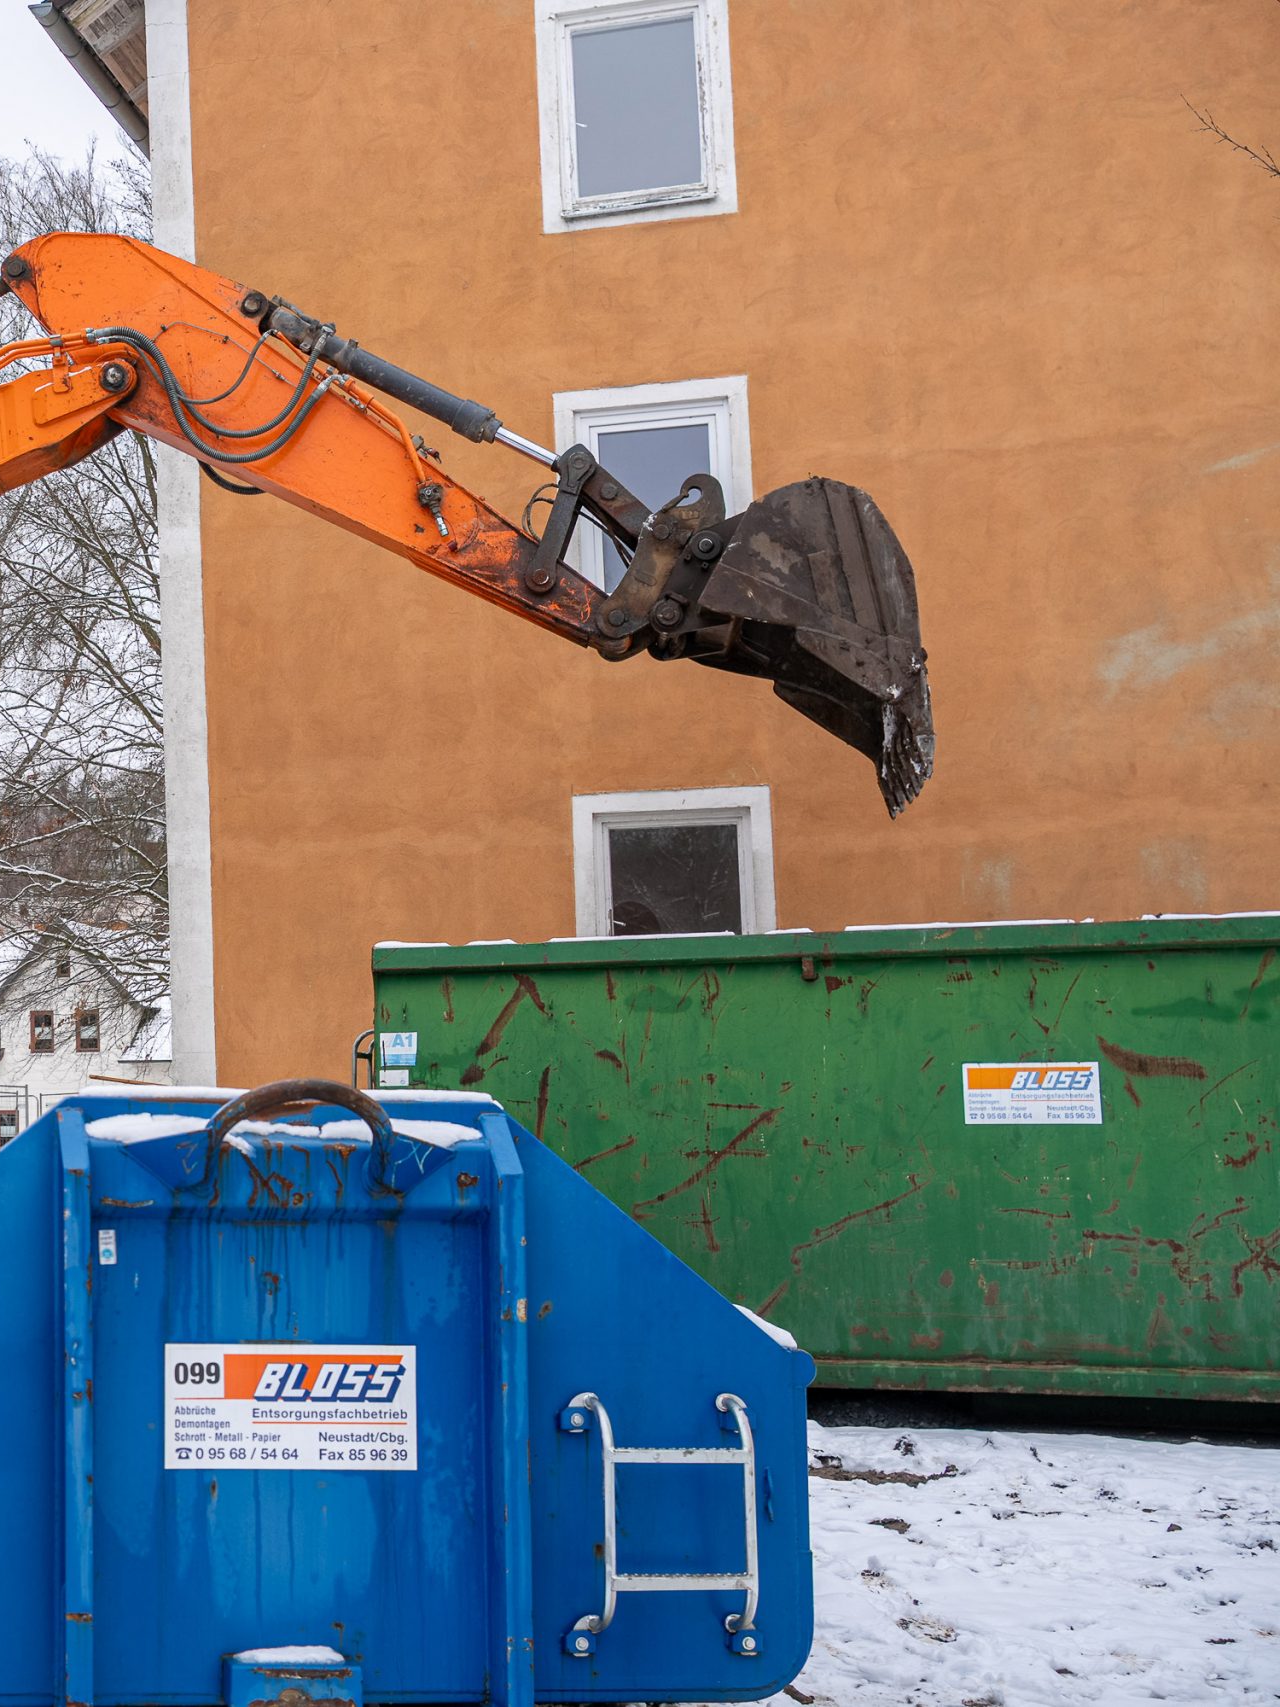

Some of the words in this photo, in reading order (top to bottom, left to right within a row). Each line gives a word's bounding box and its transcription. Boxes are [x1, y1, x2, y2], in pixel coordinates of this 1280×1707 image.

[392, 1034, 413, 1047] A1
[1010, 1071, 1094, 1090] BLOSS
[1011, 1092, 1095, 1100] Entsorgungsfachbetrieb
[174, 1362, 221, 1385] 099
[253, 1363, 407, 1402] BLOSS
[174, 1405, 216, 1415] Abbrüche
[252, 1408, 408, 1420] Entsorgungsfachbetrieb
[174, 1419, 231, 1430] Demontagen
[174, 1432, 206, 1442] Schrott
[214, 1432, 243, 1442] Metall
[252, 1432, 281, 1443] Papier
[318, 1432, 408, 1445] Neustadt/Cbg.
[195, 1447, 204, 1460] 0
[208, 1447, 225, 1460] 95
[229, 1447, 246, 1460] 68
[250, 1447, 257, 1460] /
[260, 1447, 277, 1460] 54
[282, 1447, 298, 1460] 64
[319, 1448, 344, 1461] Fax
[348, 1448, 366, 1461] 85
[370, 1448, 387, 1461] 96
[391, 1448, 408, 1461] 39
